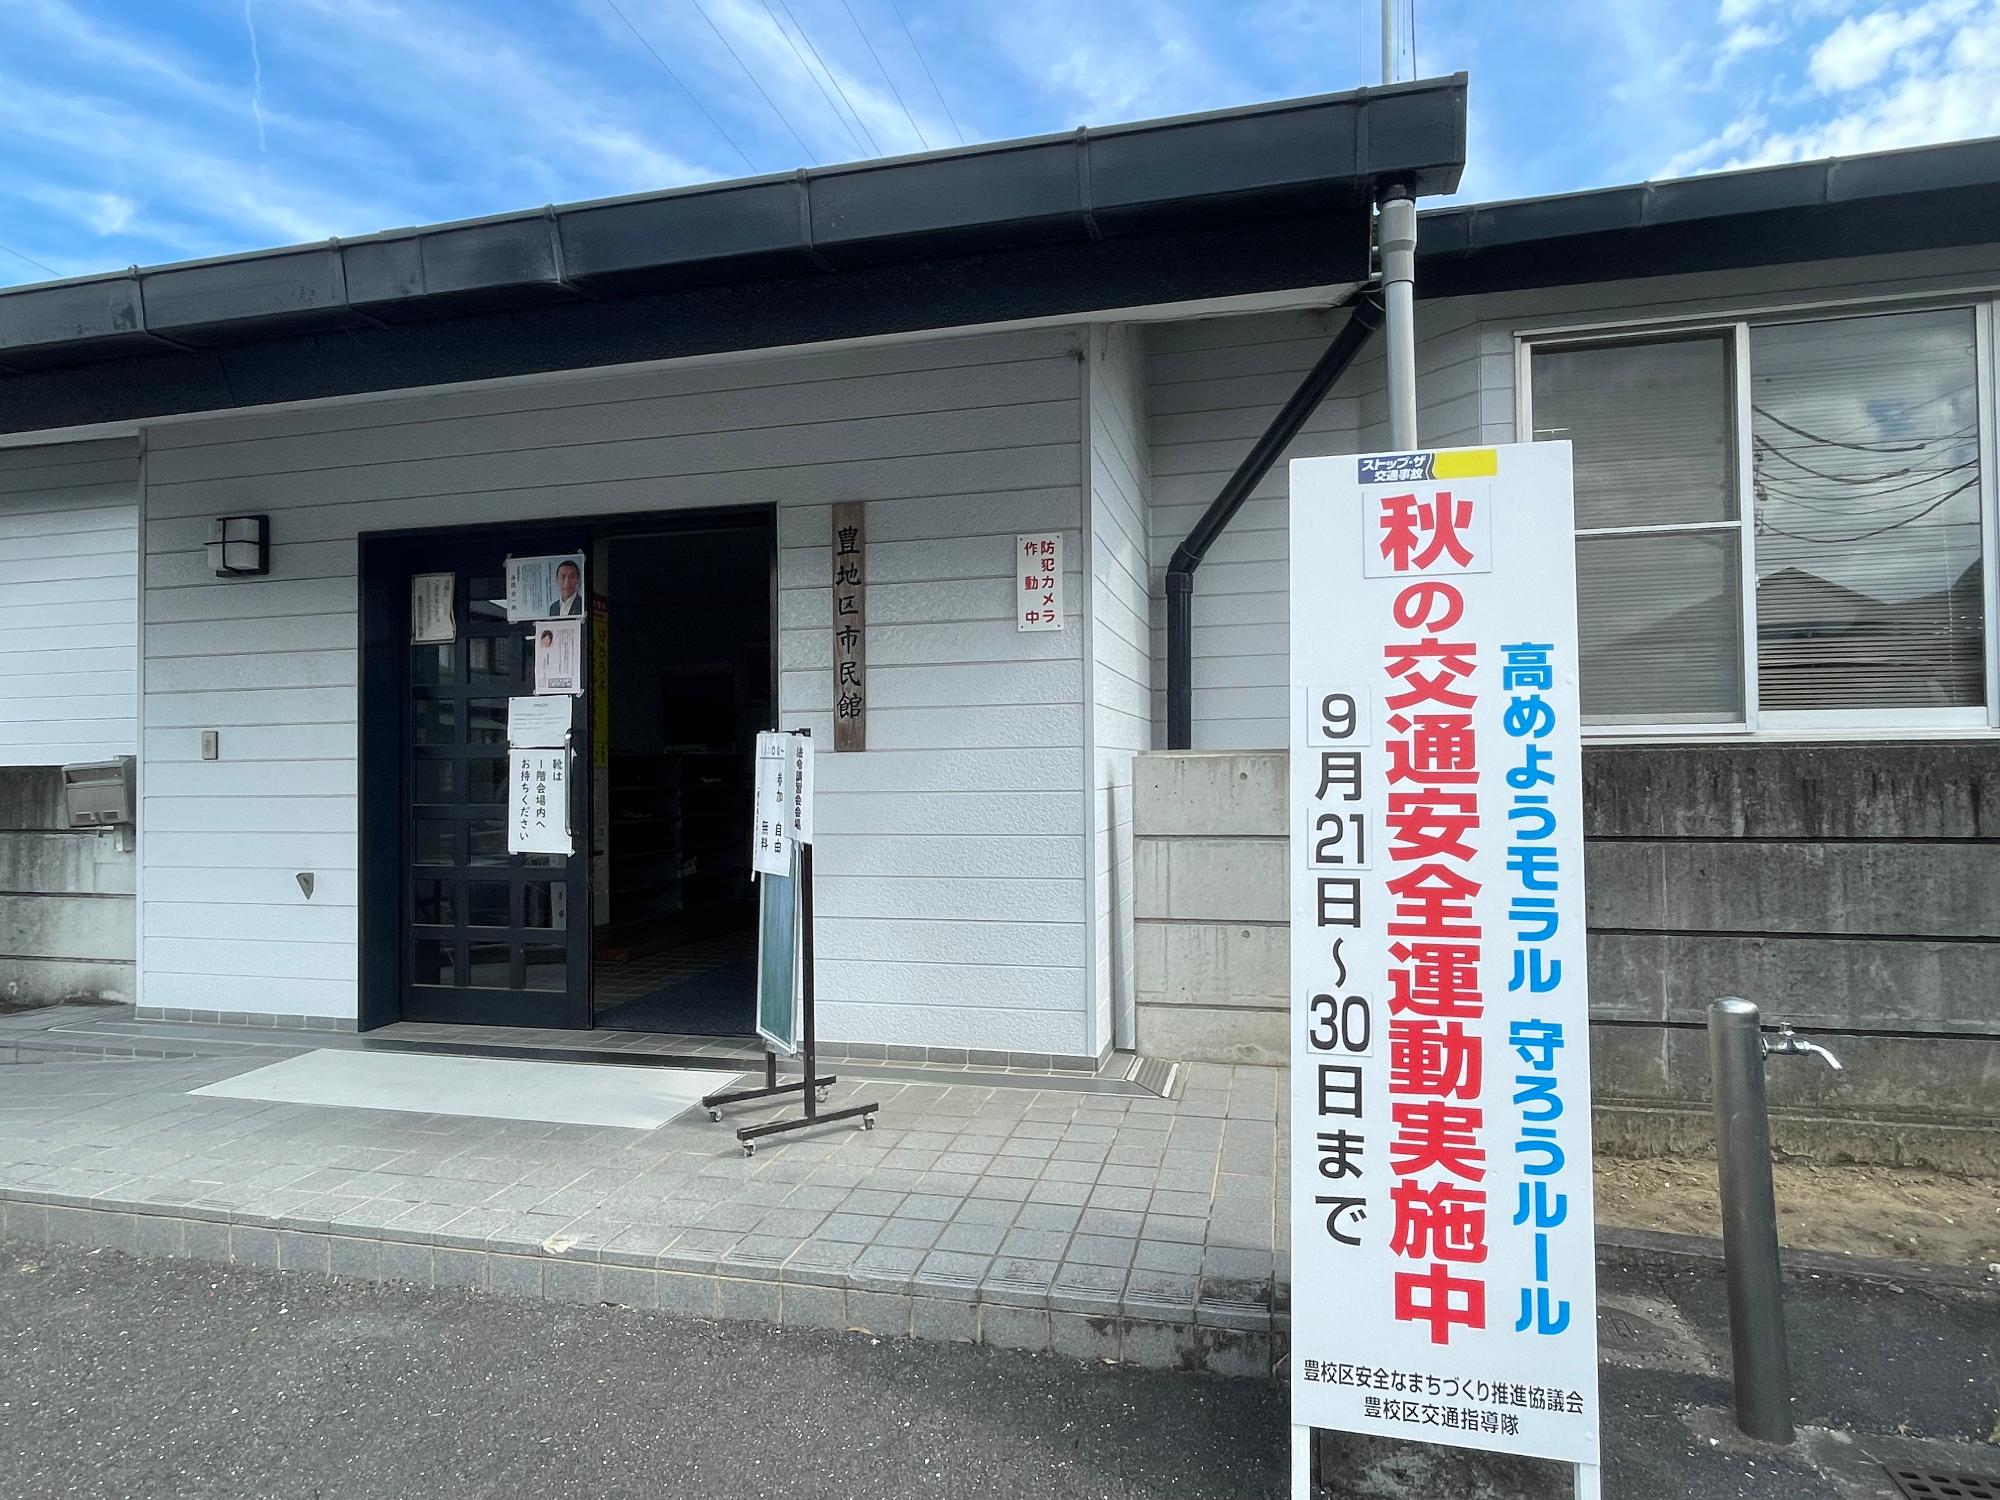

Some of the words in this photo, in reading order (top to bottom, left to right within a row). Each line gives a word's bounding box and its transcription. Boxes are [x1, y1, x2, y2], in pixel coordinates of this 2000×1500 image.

[1362, 455, 1427, 472] ストップ・ザ
[1373, 468, 1423, 482] 交通事故
[835, 525, 862, 719] 豊地区市民館
[1024, 541, 1040, 624] 作動中
[1040, 540, 1056, 623] 防犯カメラ
[519, 758, 531, 841] お持ちください
[552, 758, 563, 782] 靴は
[1501, 641, 1562, 993] 高めようモラル
[1380, 491, 1488, 1345] 秋の交通安全運動実施中
[1508, 1018, 1571, 1336] 守ろうルール
[1303, 1359, 1584, 1415] 豊校区安全なまちづくり推進協議会
[1363, 1396, 1520, 1436] 豊校区交通指導隊
